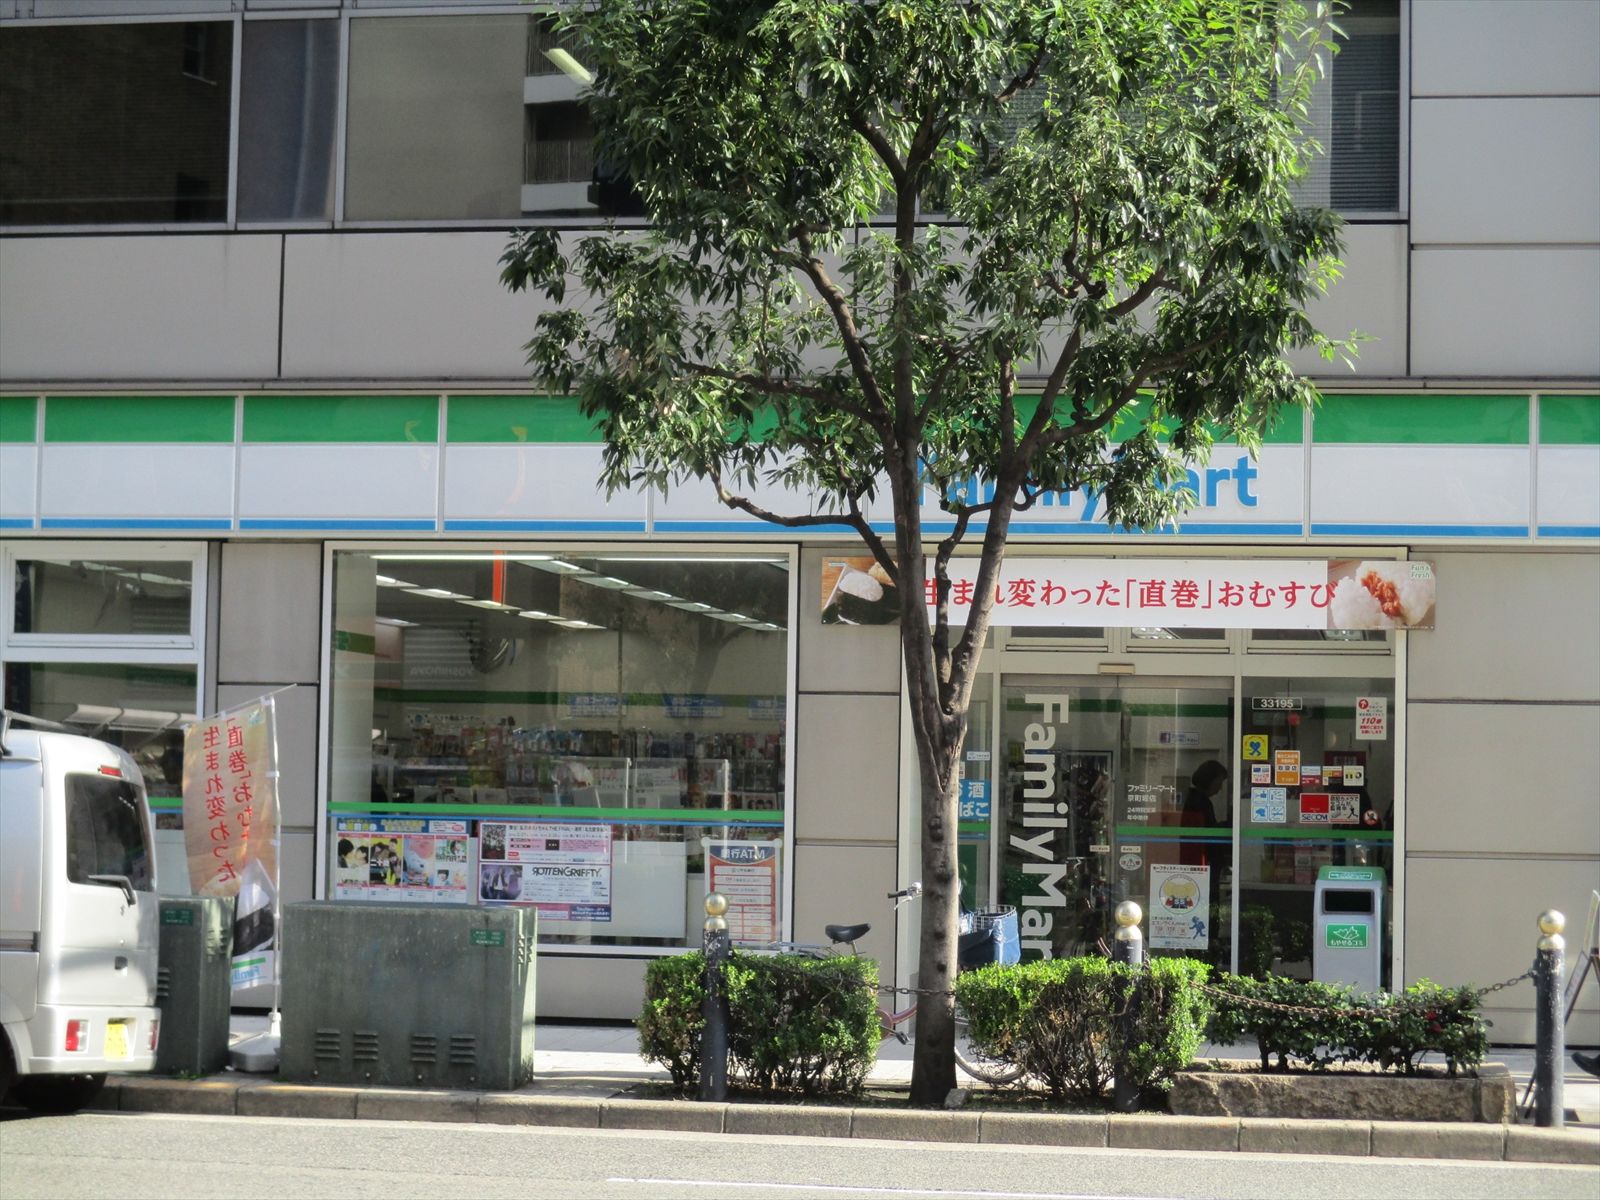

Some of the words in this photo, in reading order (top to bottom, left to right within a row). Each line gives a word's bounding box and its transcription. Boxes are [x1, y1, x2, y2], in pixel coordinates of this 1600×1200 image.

[923, 577, 1338, 609] ま変わった「直巻」おむすび
[1260, 699, 1294, 708] 33195
[1127, 784, 1176, 793] ファミリーマート
[959, 801, 989, 817] ばこ
[1010, 694, 1069, 960] FamilyMar
